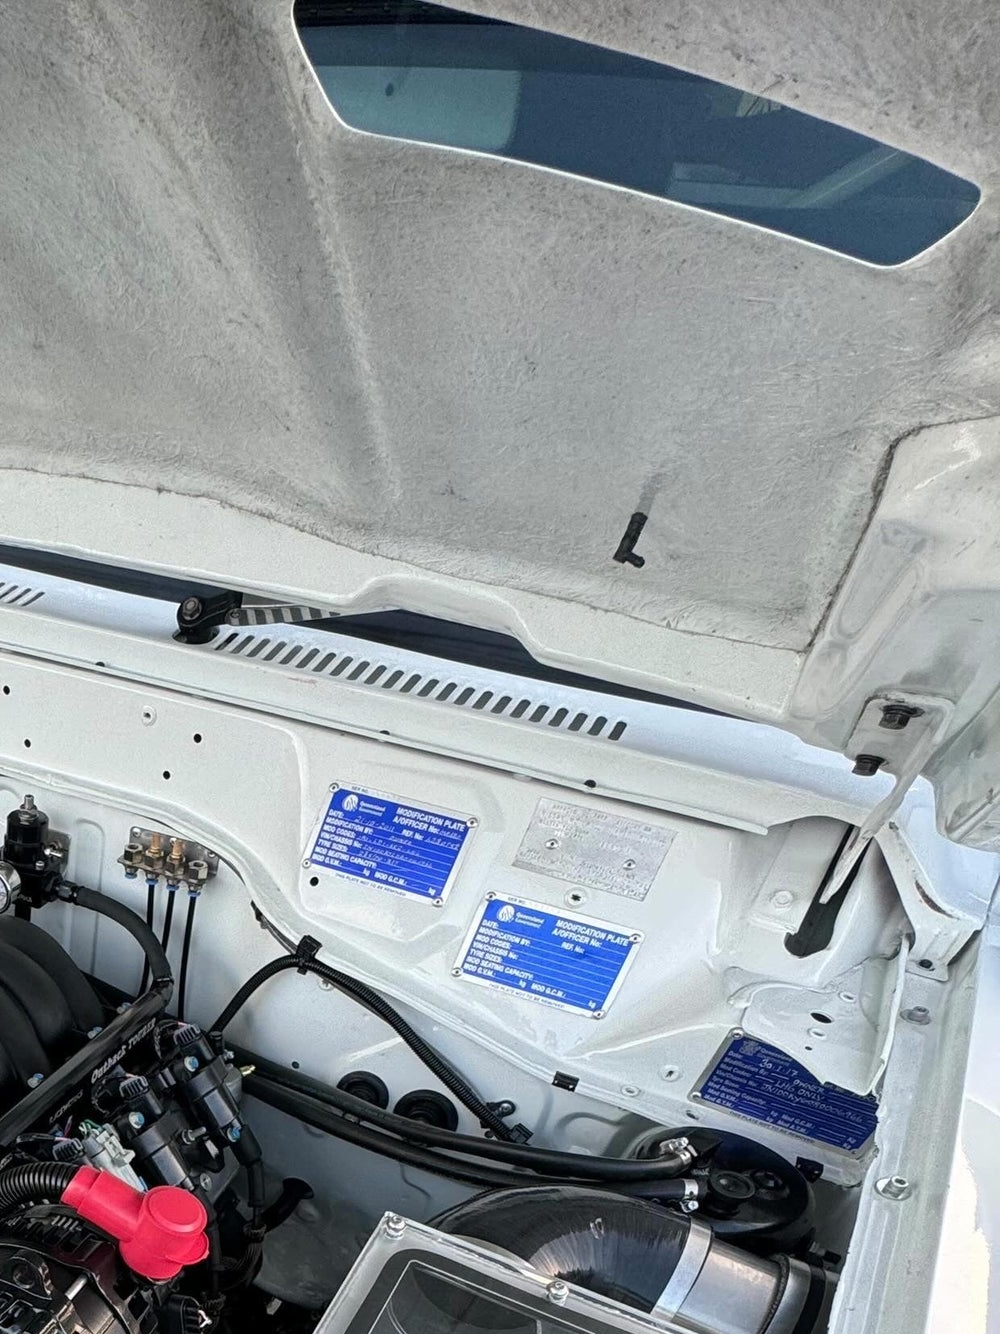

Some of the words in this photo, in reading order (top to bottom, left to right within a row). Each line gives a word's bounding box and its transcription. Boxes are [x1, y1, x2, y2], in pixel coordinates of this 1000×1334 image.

[329, 809, 343, 818] DATE:
[397, 808, 443, 825] MODIFICATION
[444, 820, 465, 831] PLATE
[326, 817, 363, 831] MODIFICATION
[394, 816, 428, 830] A/OFFICER
[318, 839, 331, 847] TYRE
[482, 920, 497, 929] DATE:
[476, 935, 489, 943] MOD
[479, 927, 520, 942] MODIFICATION
[553, 929, 589, 943] A/OFFICER
[557, 921, 606, 938] MODIFICATION
[606, 934, 630, 946] PLATE
[470, 949, 484, 958] TYRE
[467, 956, 480, 964] MOD
[481, 960, 503, 971] SEATING
